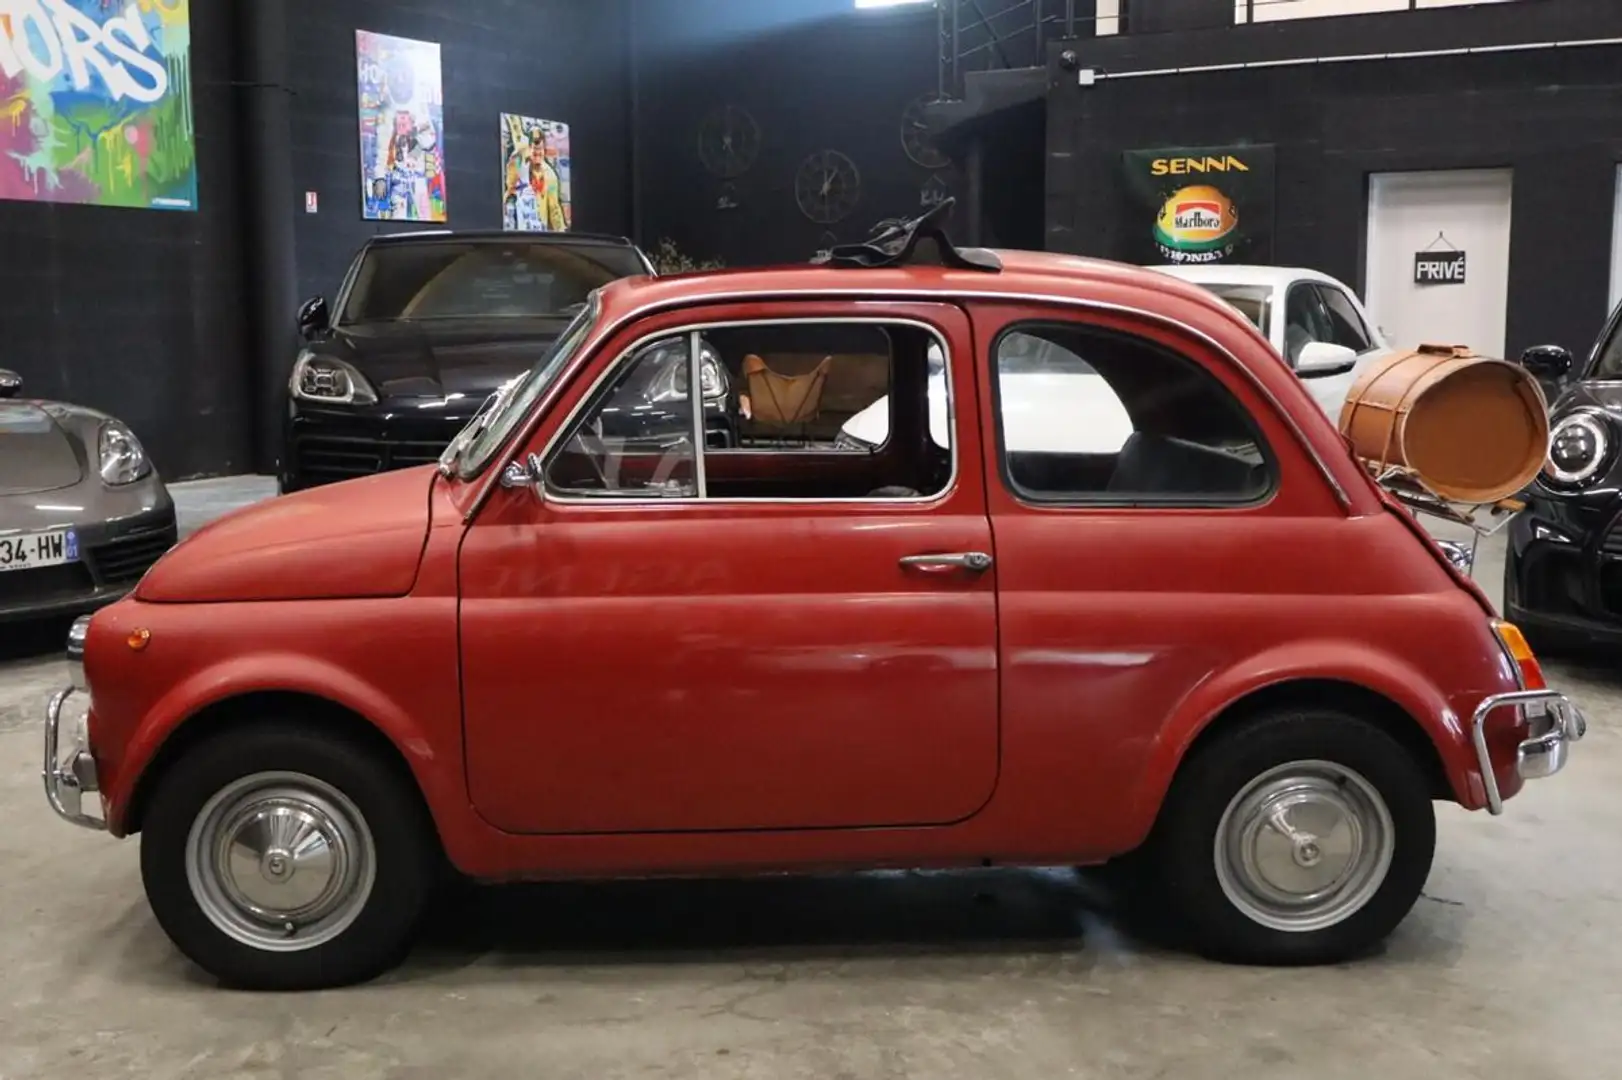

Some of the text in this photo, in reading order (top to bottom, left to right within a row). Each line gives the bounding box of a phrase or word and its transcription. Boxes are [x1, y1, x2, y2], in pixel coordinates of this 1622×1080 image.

[1151, 156, 1249, 175] SENNA
[1175, 212, 1220, 228] Marlboro
[1416, 257, 1464, 279] PRIVÉ
